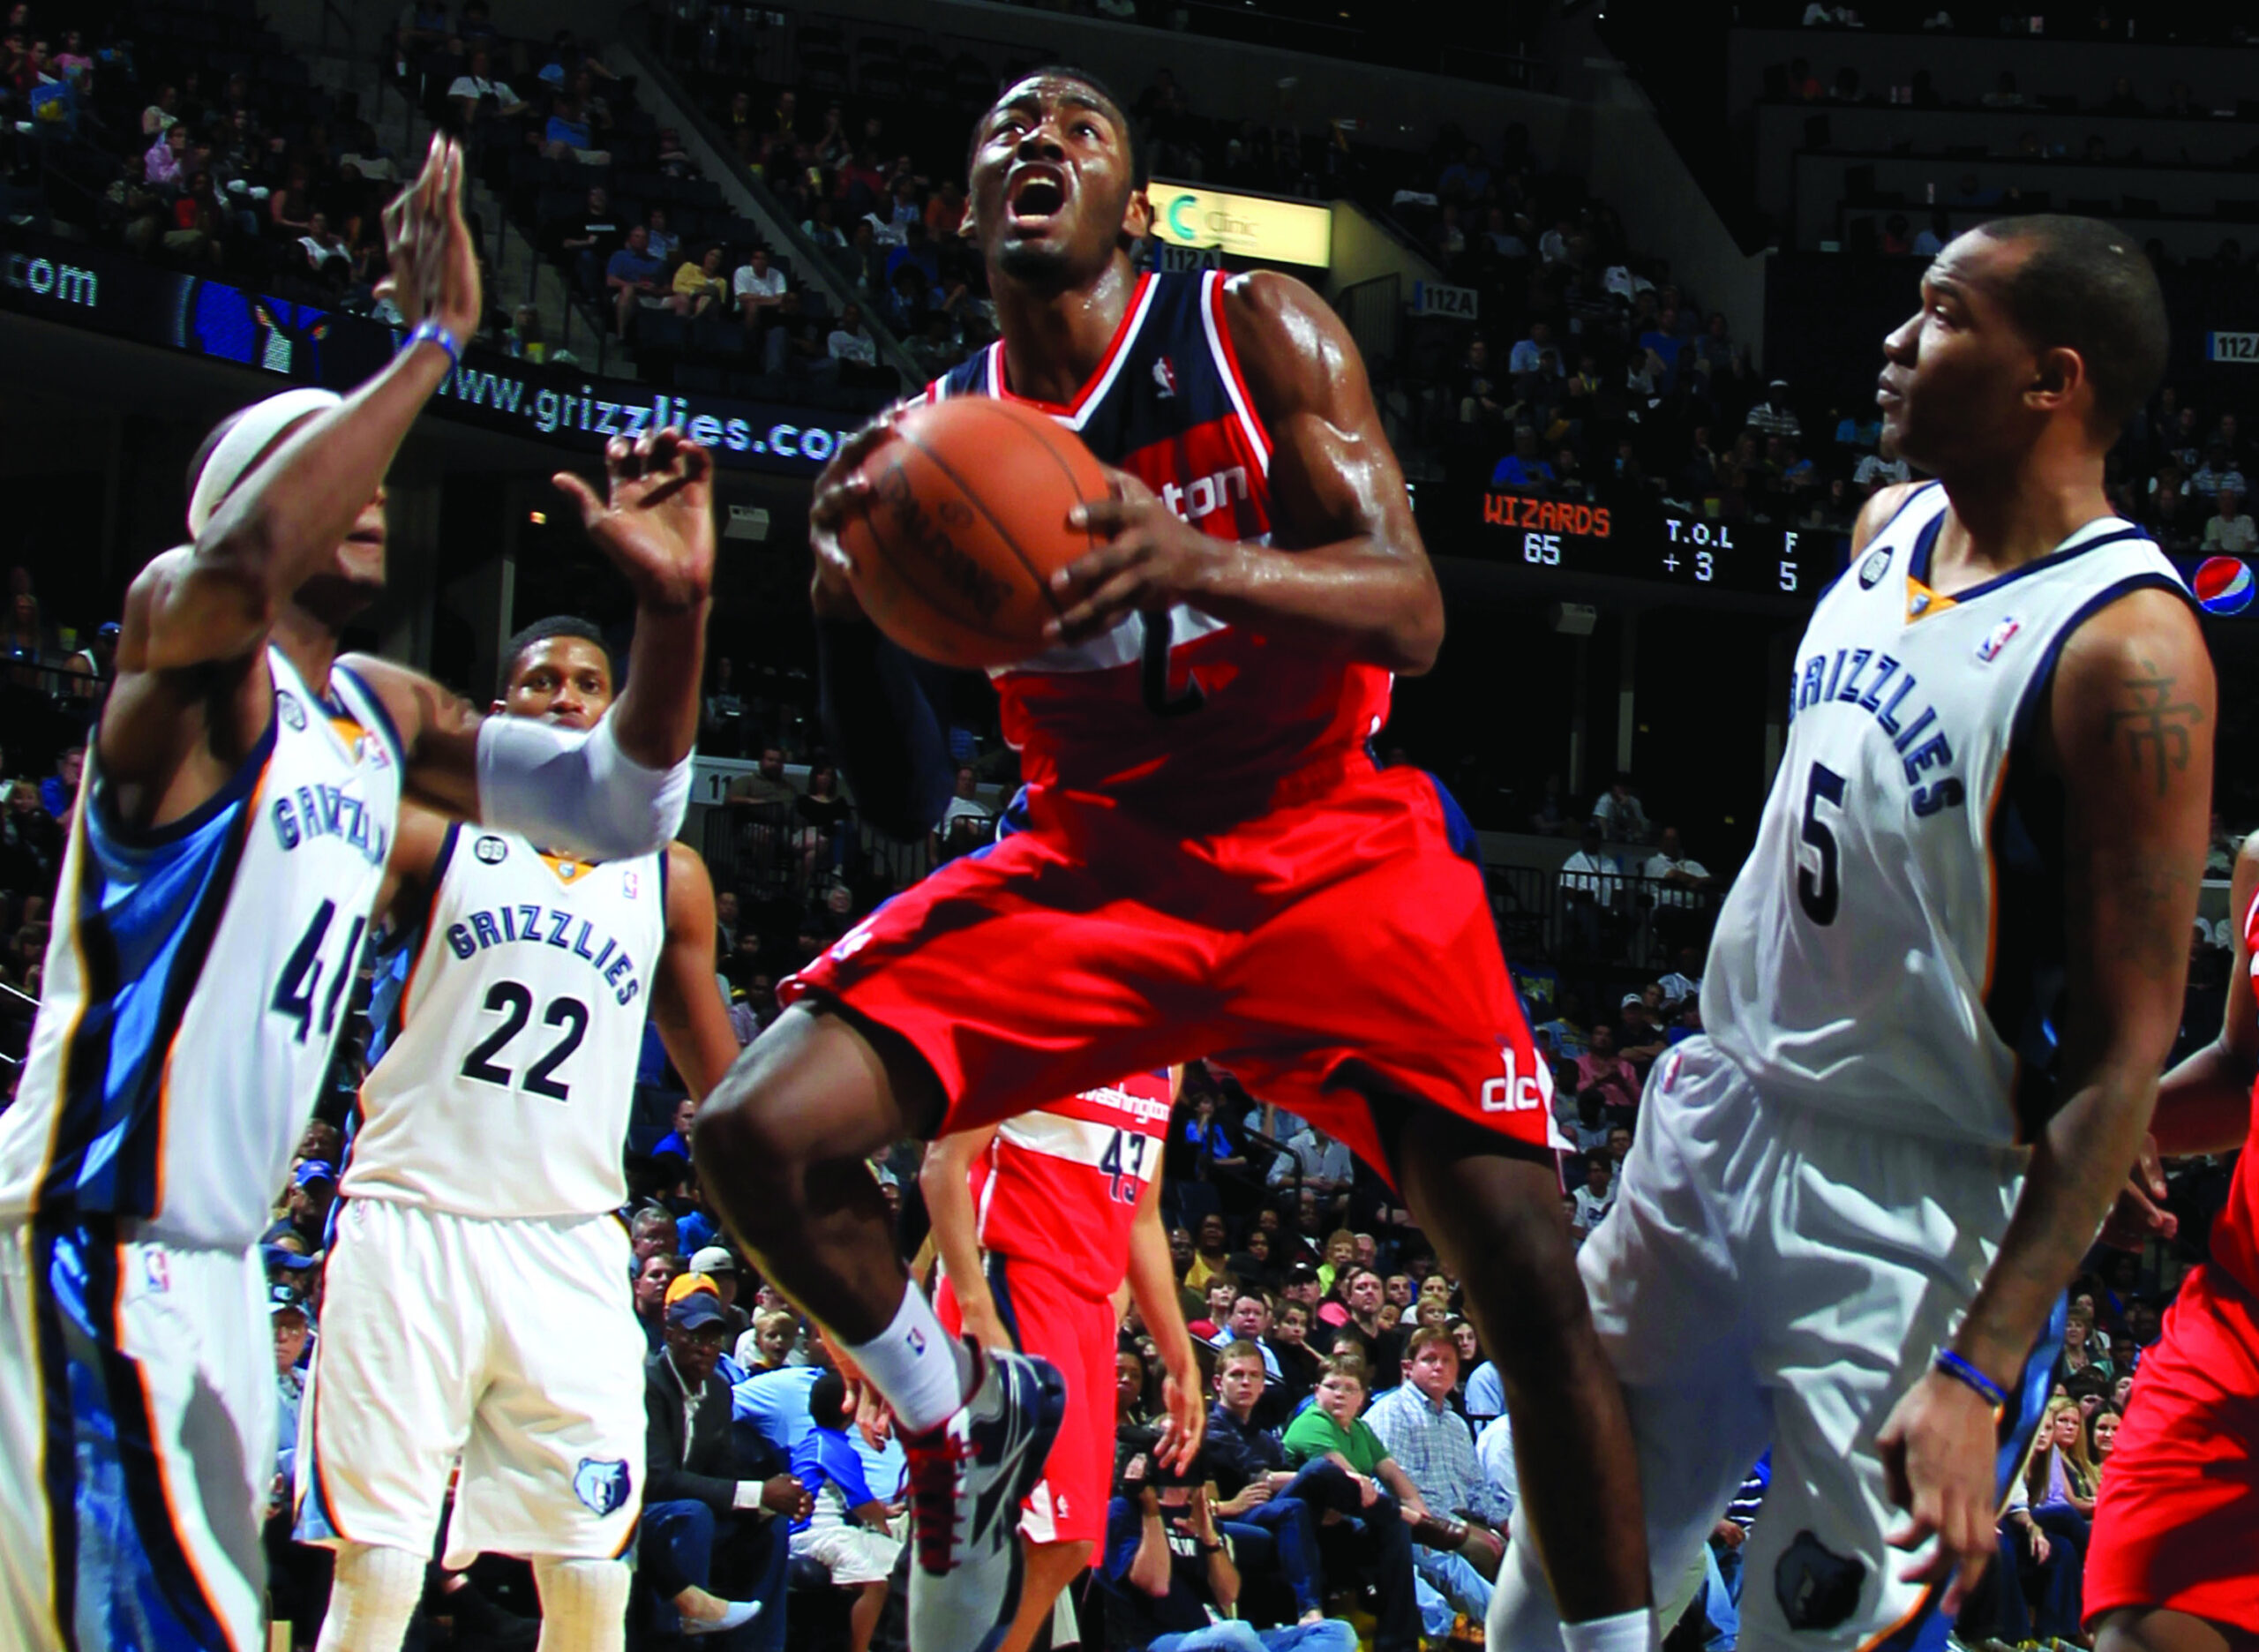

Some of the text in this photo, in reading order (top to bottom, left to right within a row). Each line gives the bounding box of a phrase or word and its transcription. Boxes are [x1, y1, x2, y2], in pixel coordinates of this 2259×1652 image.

[1425, 287, 1475, 316] 112A
[1157, 465, 1248, 523] ton
[1483, 492, 1611, 538] WIZARDS
[1523, 532, 1562, 566] 65
[1784, 531, 1798, 553] F
[1779, 560, 1798, 591] 5
[1788, 648, 1967, 819] RIZZLIES
[1796, 760, 1847, 927] 5
[446, 904, 639, 1007] GRIZZLIES
[459, 980, 589, 1102] 22
[1482, 1047, 1539, 1113] dc
[1099, 1127, 1147, 1205] 43
